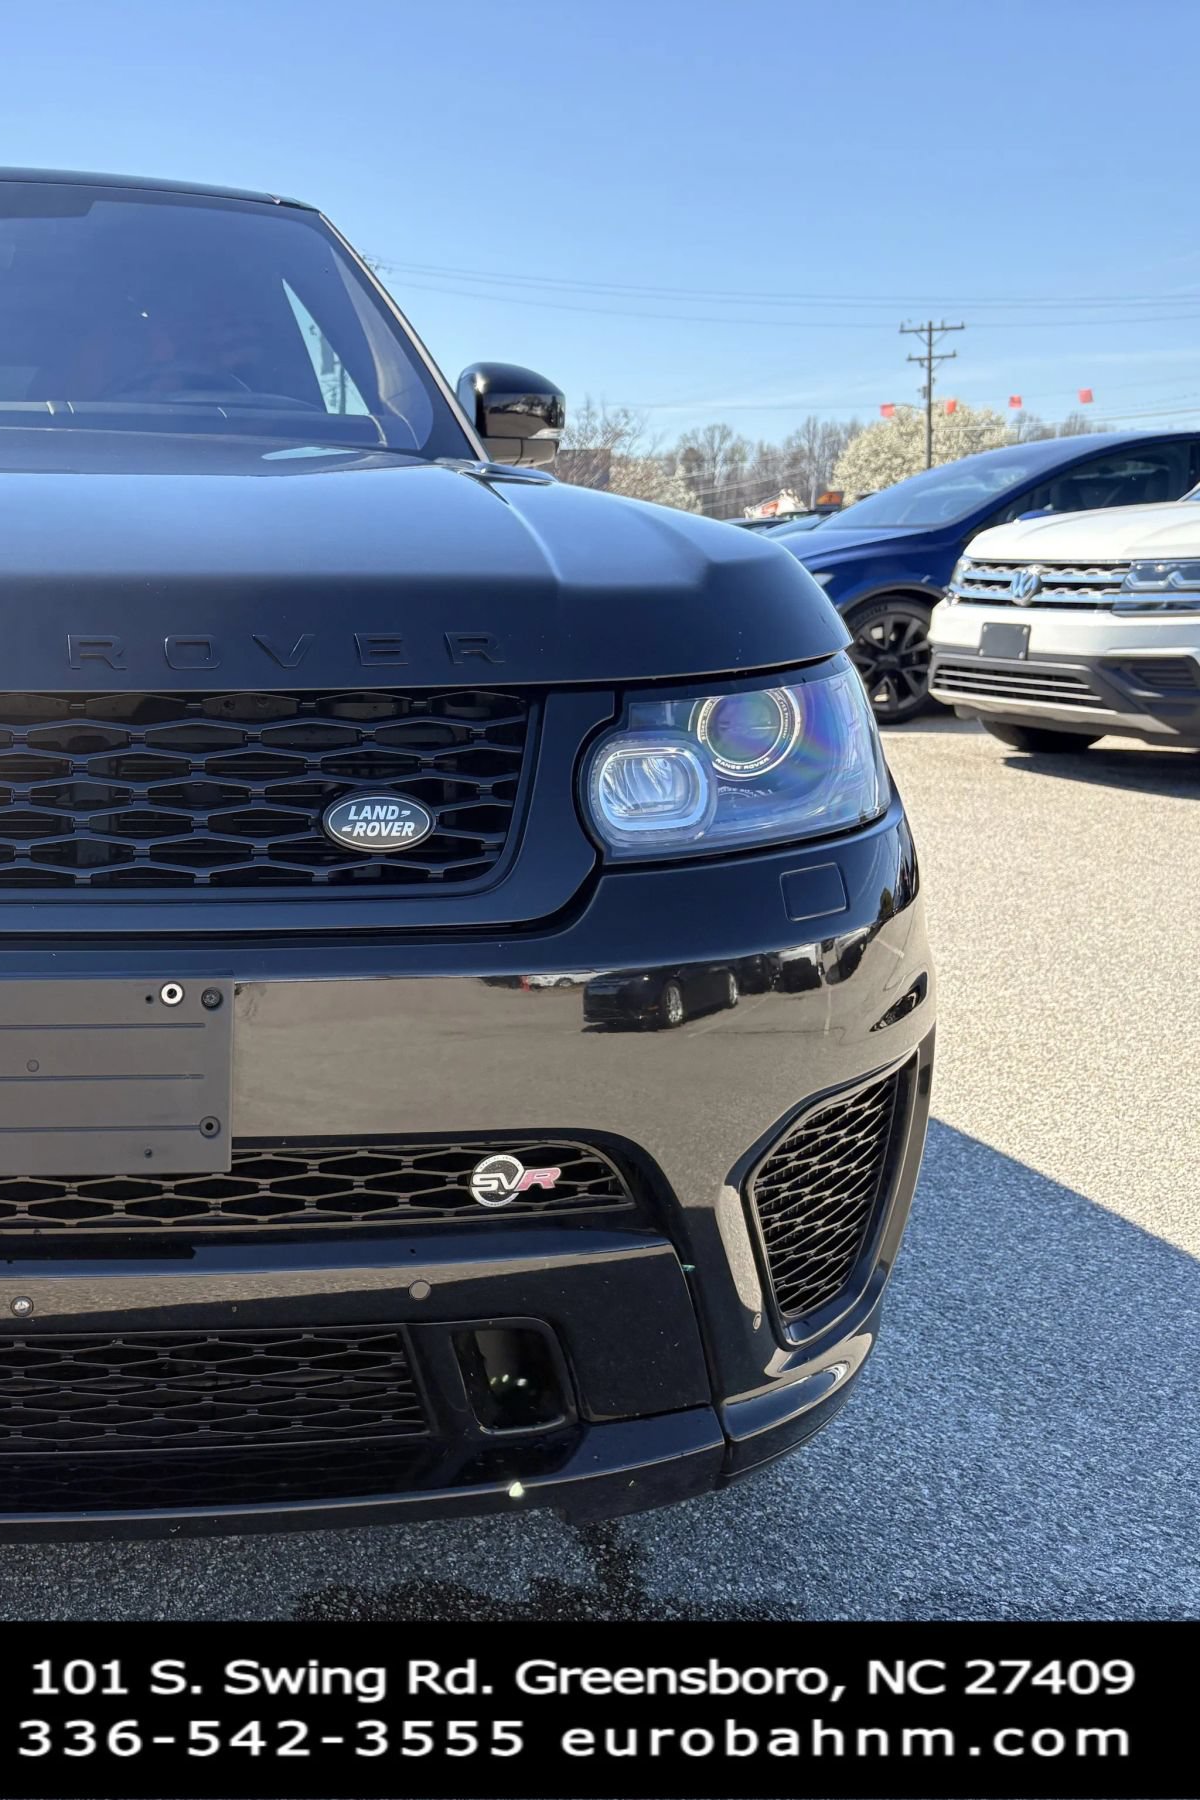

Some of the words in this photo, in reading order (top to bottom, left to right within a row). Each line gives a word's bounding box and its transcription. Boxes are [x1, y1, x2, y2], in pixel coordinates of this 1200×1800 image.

[66, 631, 506, 669] ROVER
[715, 757, 741, 770] RANGE
[744, 756, 770, 770] ROVER
[348, 805, 400, 820] LAND
[352, 821, 415, 837] ROVER
